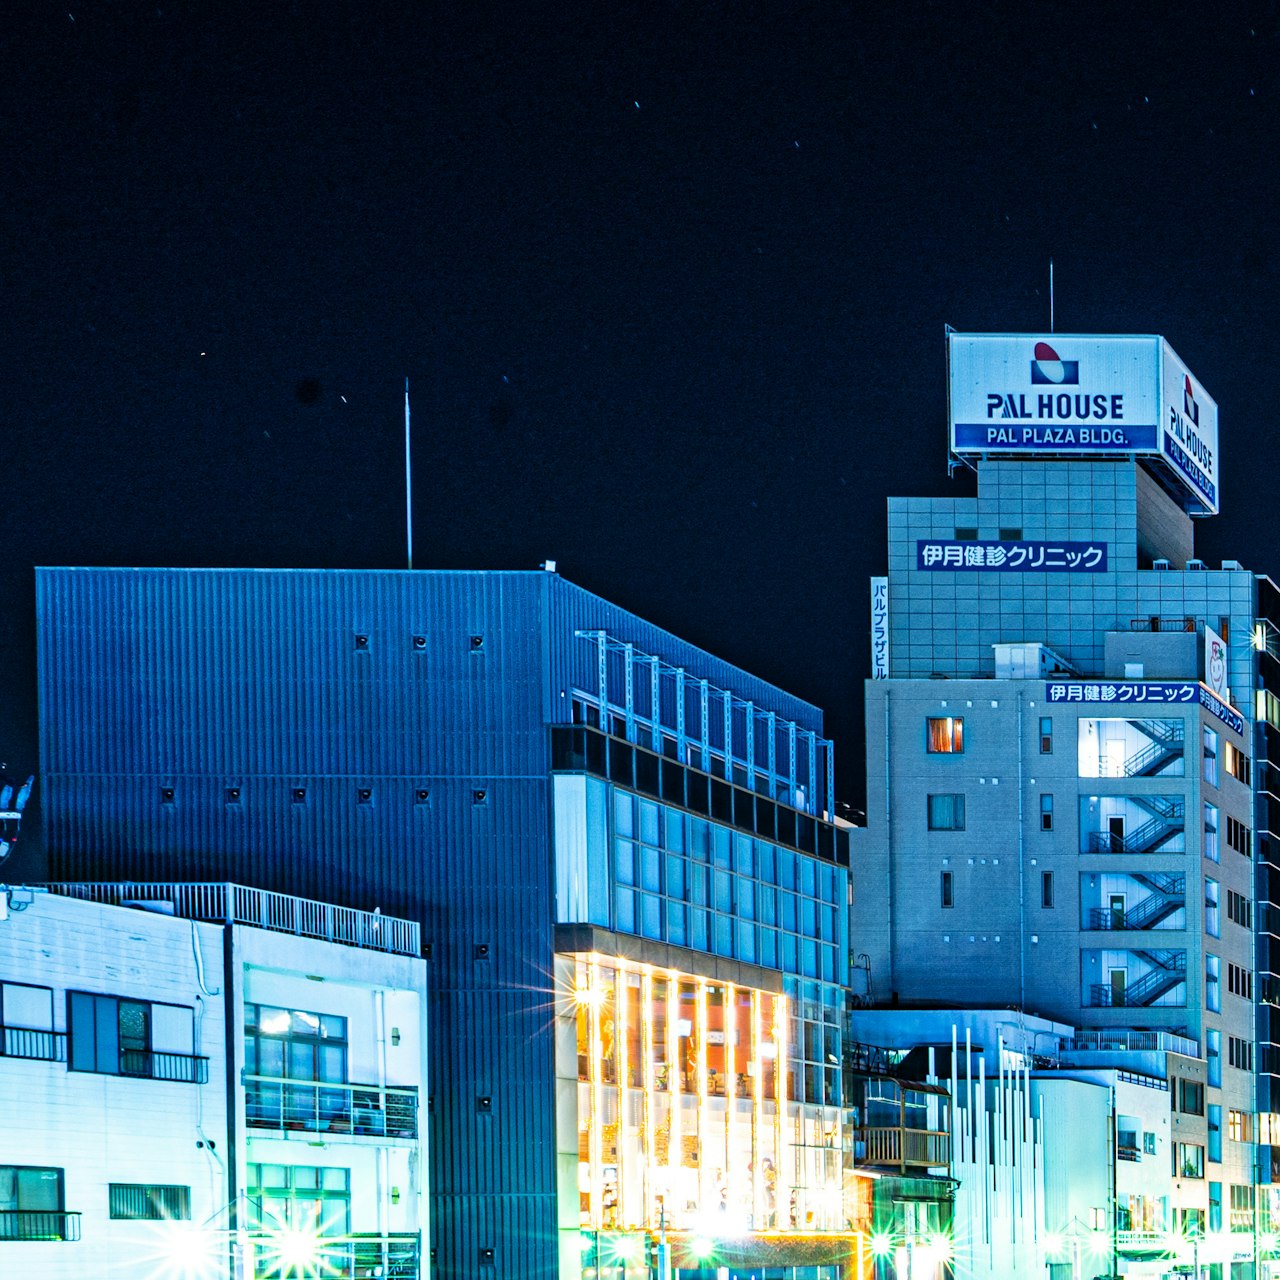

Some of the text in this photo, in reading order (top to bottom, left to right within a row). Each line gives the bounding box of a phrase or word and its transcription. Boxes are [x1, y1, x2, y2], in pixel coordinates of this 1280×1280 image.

[987, 393, 1123, 420] PAL HOUSE
[987, 428, 1129, 445] PAL PLAZA BLDG.
[1171, 406, 1213, 475] PAL HOUSE
[1170, 439, 1182, 462] PAL
[1181, 454, 1199, 486] PLAZA
[922, 545, 1103, 568] 伊月健診クリニック
[874, 585, 887, 680] パルプラザビル
[1049, 684, 1195, 702] 伊月健診クリニック
